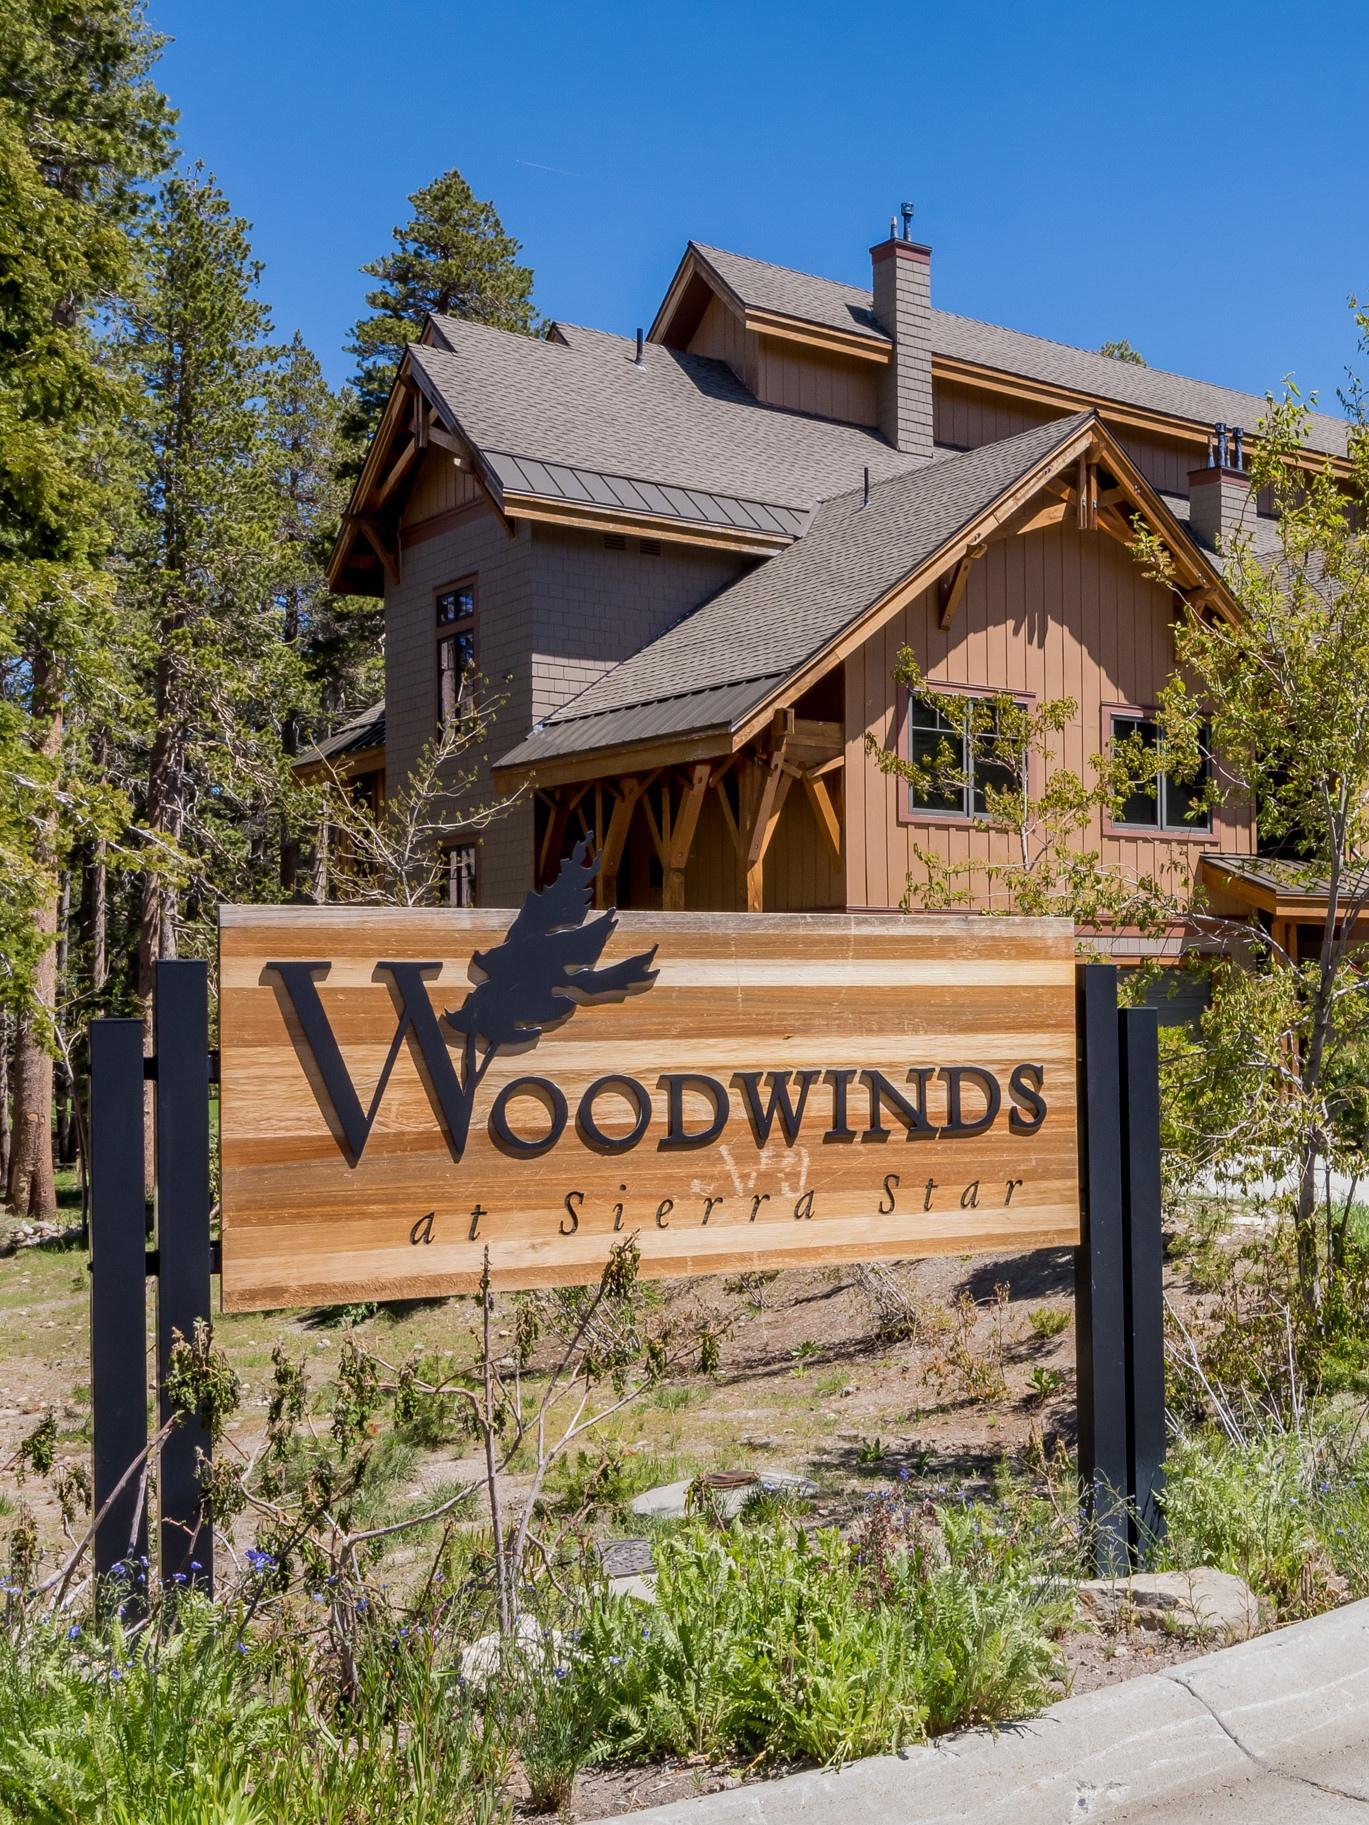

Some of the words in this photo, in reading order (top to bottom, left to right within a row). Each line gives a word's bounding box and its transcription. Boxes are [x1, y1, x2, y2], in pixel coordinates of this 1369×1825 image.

[410, 1204, 488, 1245] at
[559, 1184, 816, 1236] Sierra
[878, 1173, 1024, 1216] Star
